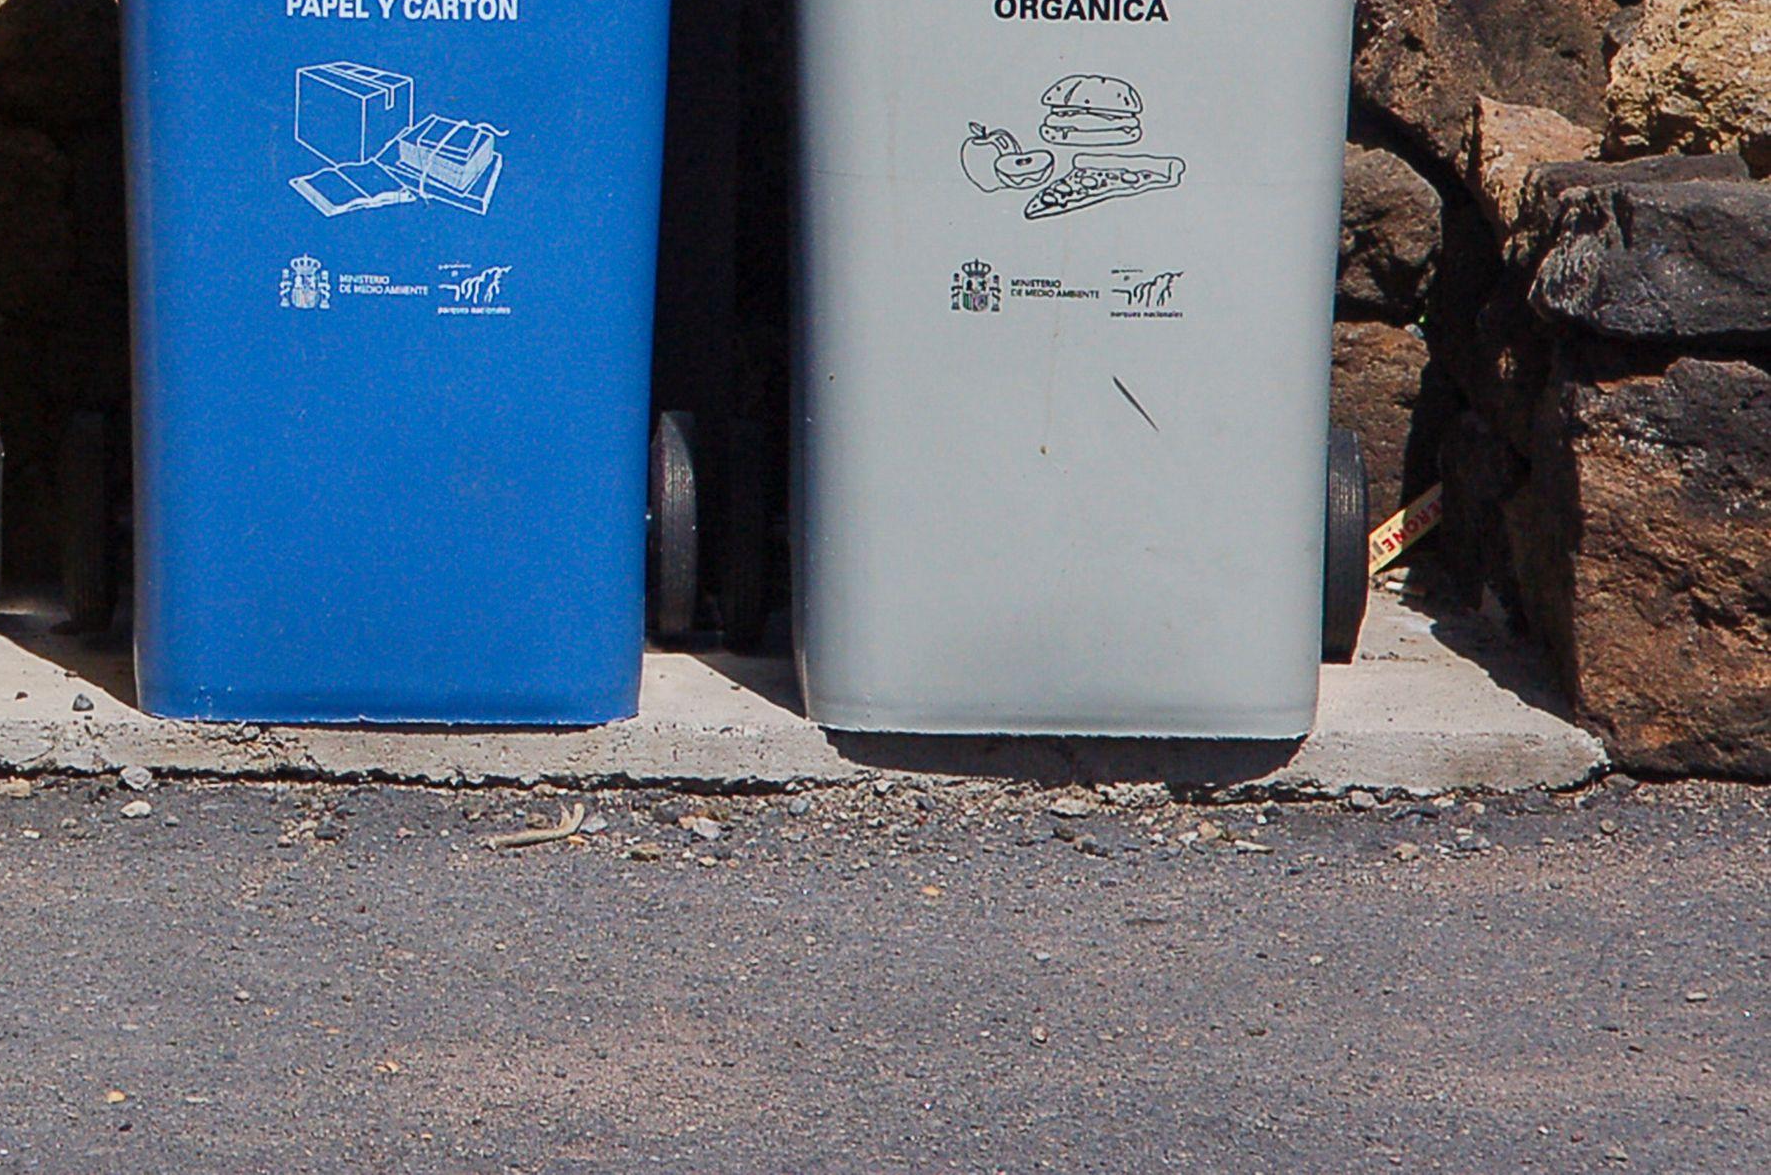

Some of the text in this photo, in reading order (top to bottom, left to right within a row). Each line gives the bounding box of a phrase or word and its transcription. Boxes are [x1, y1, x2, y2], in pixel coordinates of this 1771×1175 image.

[339, 284, 352, 294] DE
[353, 284, 384, 295] MEDIO
[1010, 279, 1062, 289] MINISTERIO
[1010, 288, 1100, 300] DE MEDIO AMBIENTE
